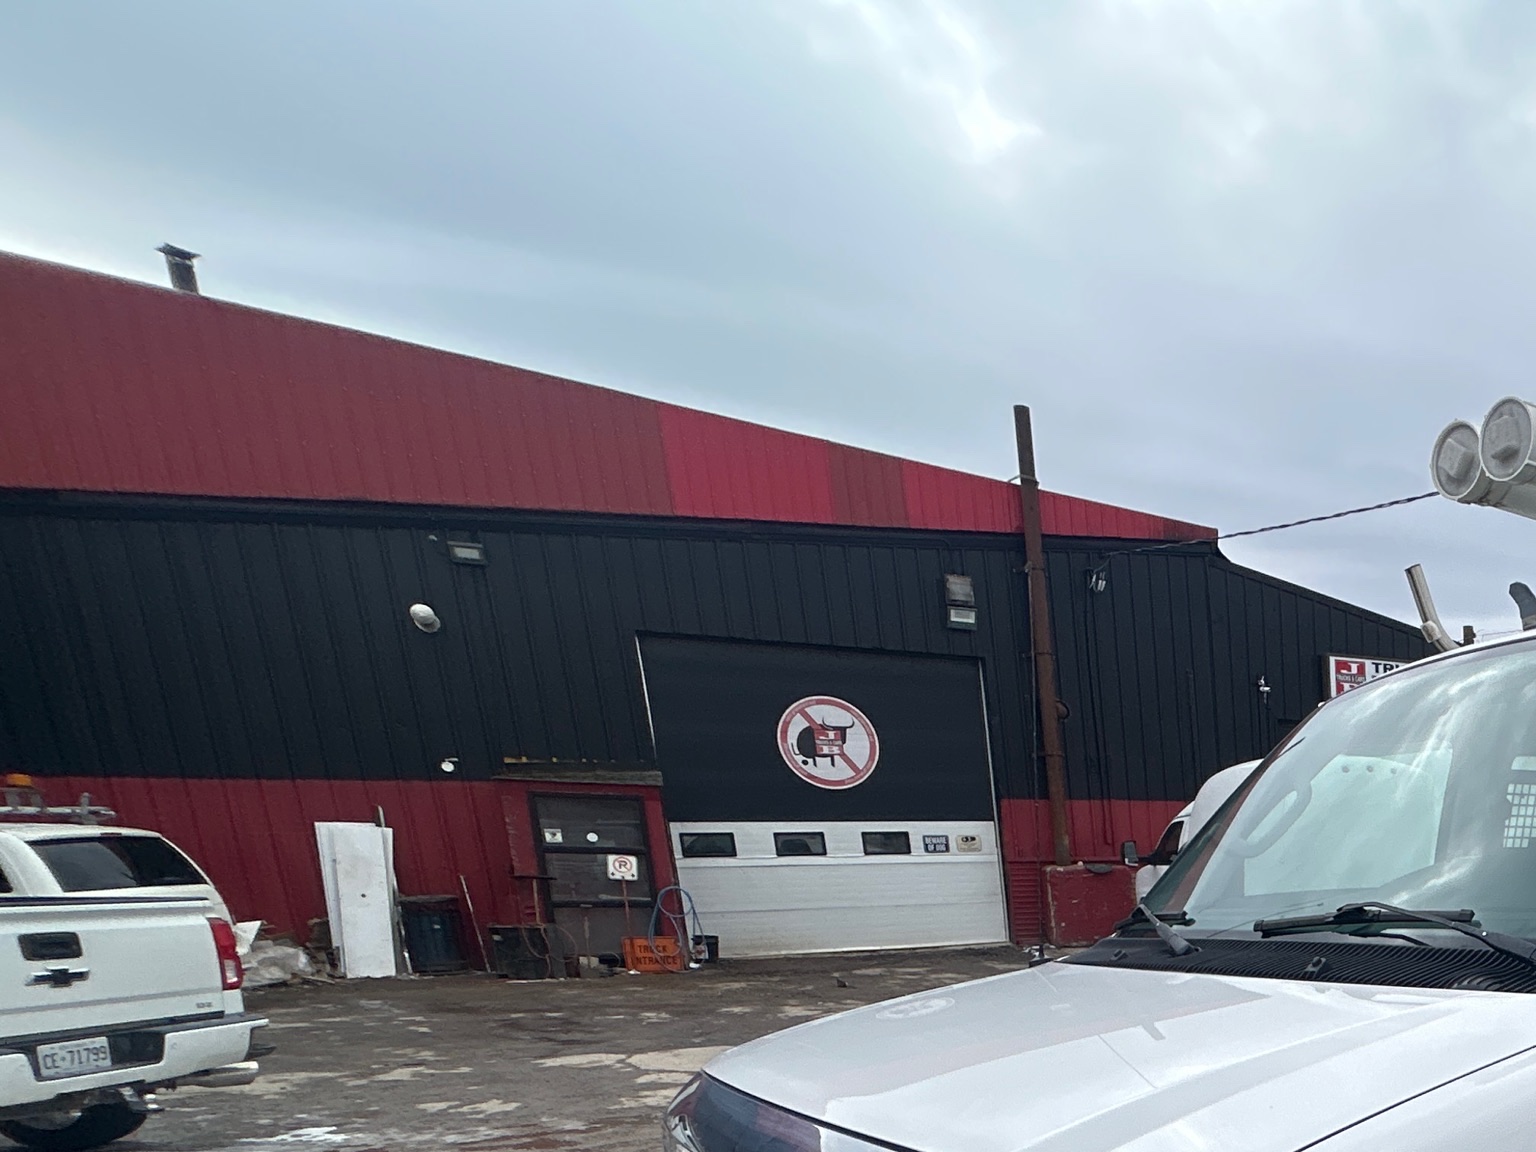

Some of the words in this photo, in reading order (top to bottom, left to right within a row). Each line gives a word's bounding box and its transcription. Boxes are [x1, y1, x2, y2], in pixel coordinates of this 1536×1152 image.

[1340, 662, 1359, 674] J
[1372, 662, 1400, 674] TR
[925, 836, 947, 845] BEWARE
[634, 956, 678, 966] NTRANCE
